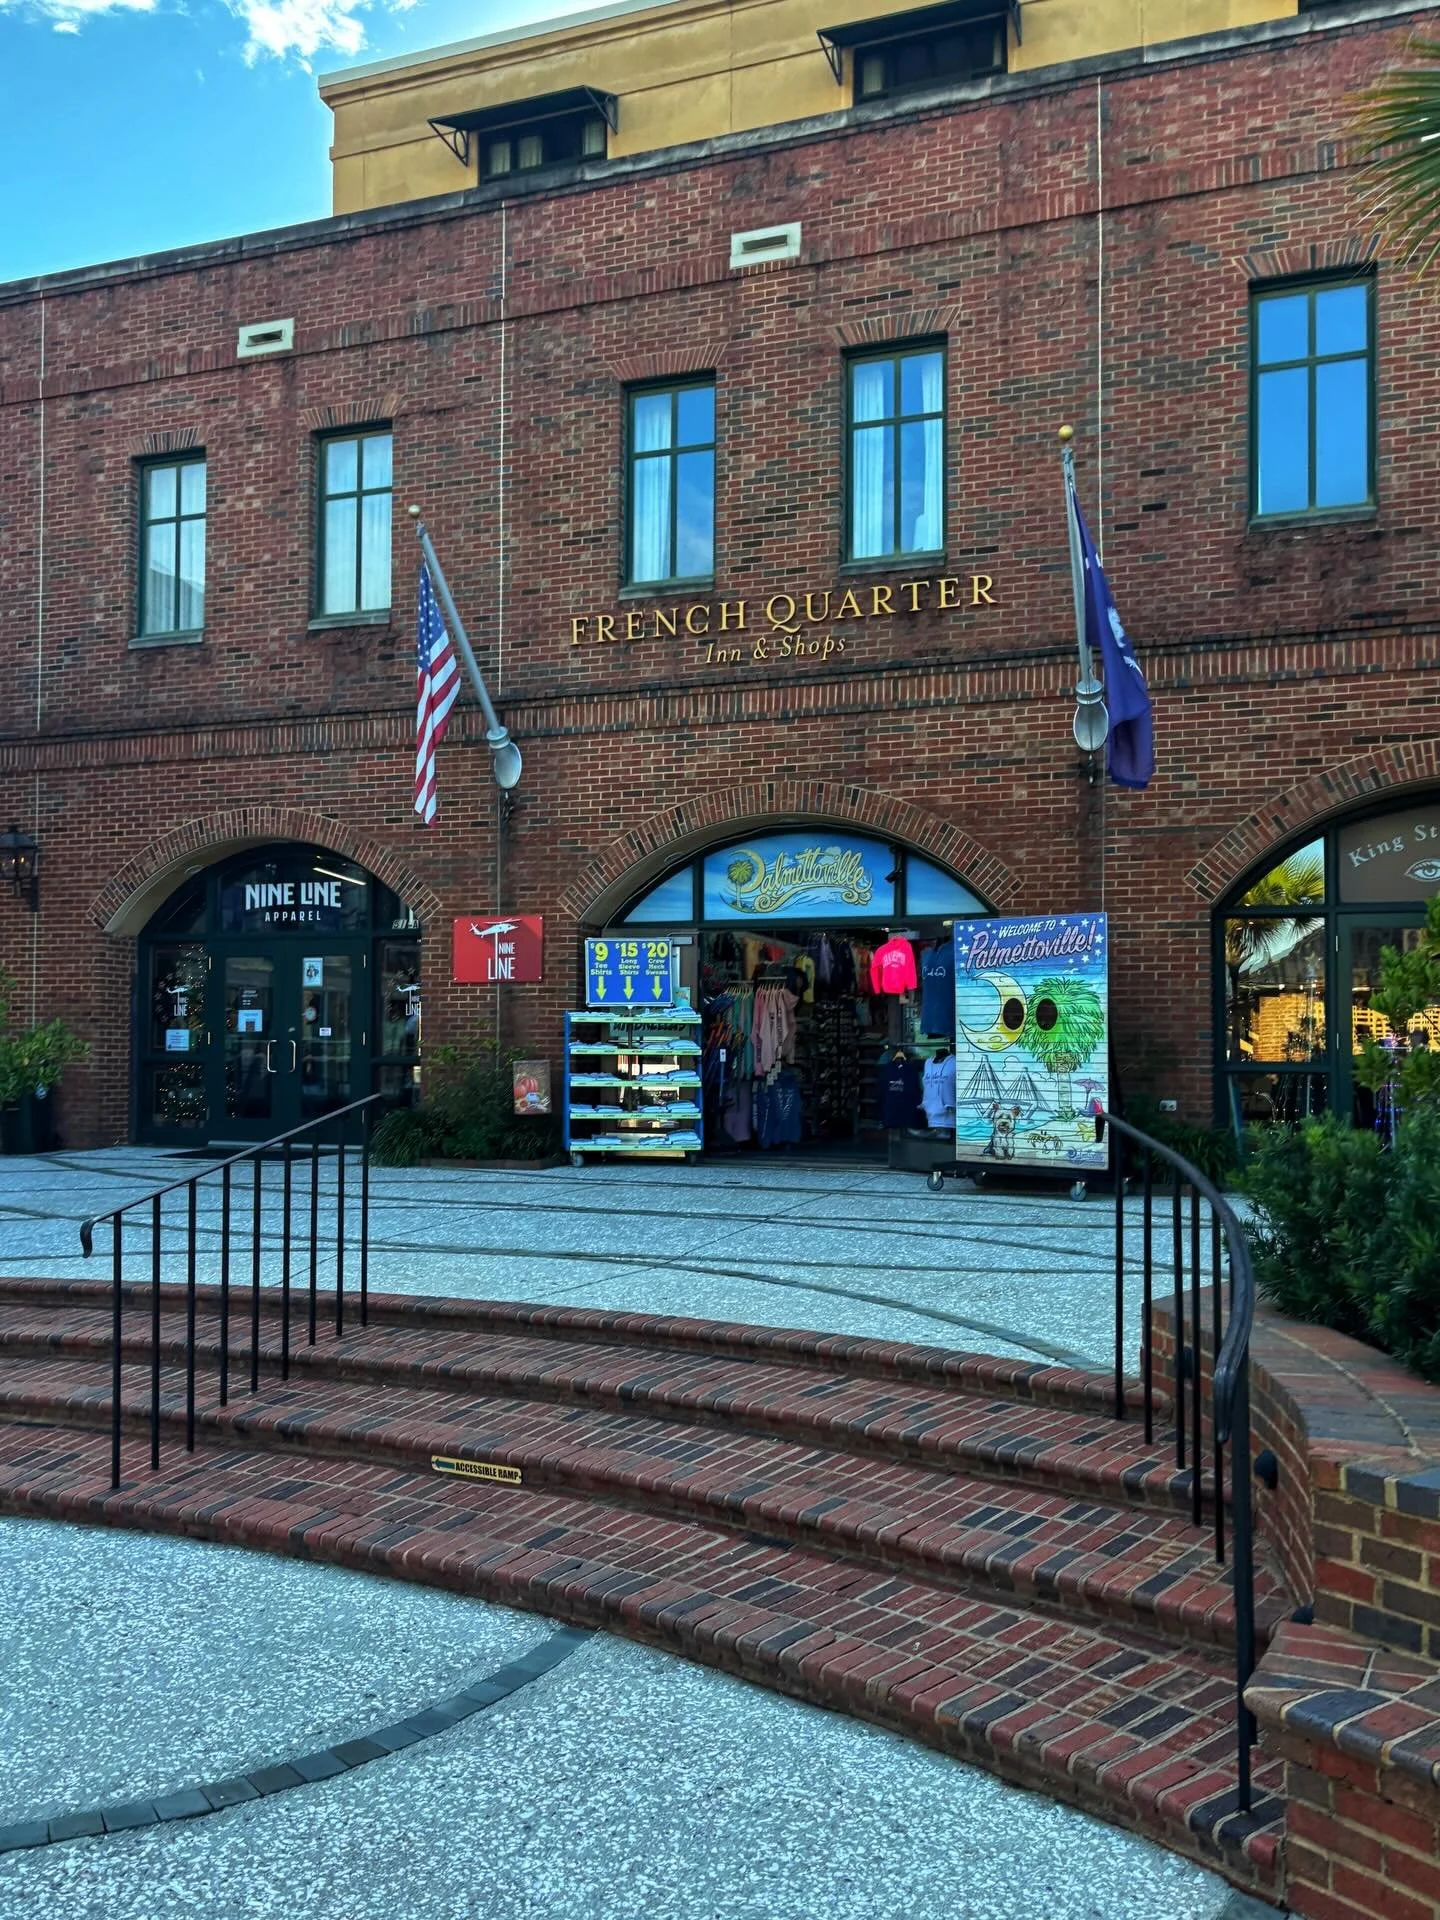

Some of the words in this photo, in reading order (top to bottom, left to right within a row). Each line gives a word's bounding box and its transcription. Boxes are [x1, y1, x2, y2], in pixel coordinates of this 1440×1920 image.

[570, 599, 749, 647] FRENCH
[766, 574, 999, 634] QUARTER
[706, 643, 742, 665] Inn
[753, 637, 770, 660] &
[780, 634, 847, 663] Shops
[1348, 836, 1405, 868] King
[245, 882, 295, 911] NINE
[300, 881, 342, 909] LINE
[264, 910, 321, 922] APPAREL
[999, 921, 1042, 939] WELCOME
[1043, 919, 1057, 932] TO
[498, 942, 516, 955] NINE
[966, 920, 1097, 975] Palmettoville!
[487, 957, 516, 980] LINE
[590, 968, 613, 976] Shirts
[455, 1462, 497, 1477] ACCESSIBLE
[498, 1468, 519, 1480] RAMP
